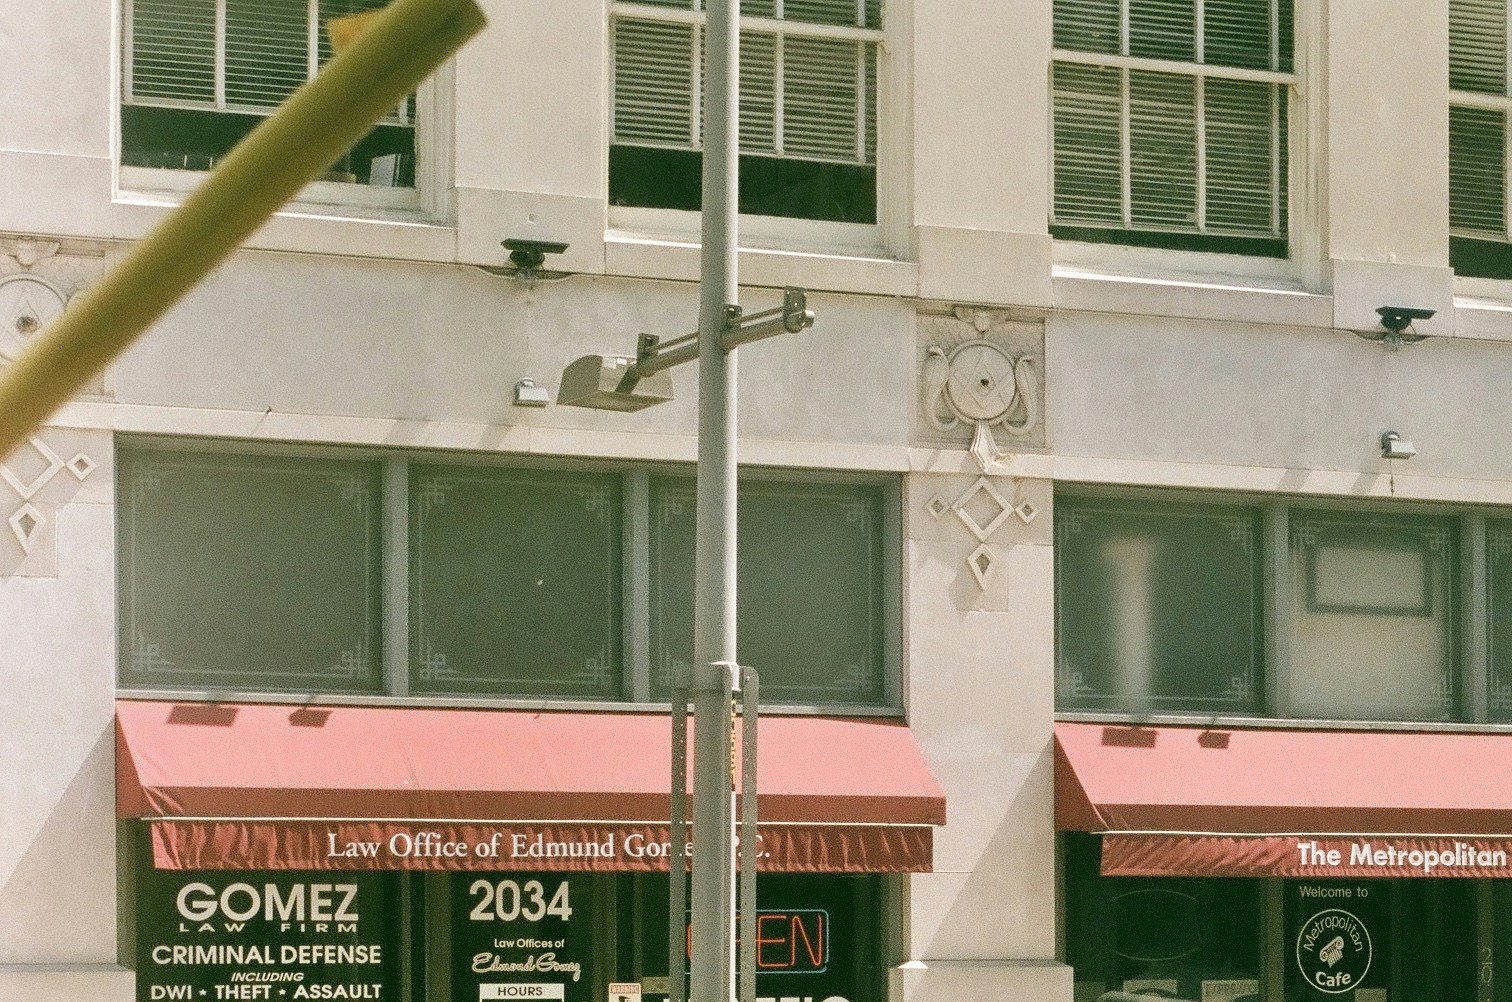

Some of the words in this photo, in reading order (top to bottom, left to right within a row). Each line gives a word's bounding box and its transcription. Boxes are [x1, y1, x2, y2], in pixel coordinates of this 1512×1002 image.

[327, 832, 381, 858] Law
[389, 832, 468, 858] Office
[475, 832, 503, 858] of
[511, 832, 616, 858] Edmund
[624, 833, 695, 858] Goe
[1297, 841, 1341, 866] The
[1349, 842, 1507, 873] Metropolitan
[1299, 886, 1352, 898] Welcome
[1357, 886, 1369, 898] to
[176, 882, 359, 922] GOMEZ
[469, 879, 573, 922] 2034
[179, 923, 246, 933] LAW
[280, 923, 358, 933] FIRM
[1303, 915, 1363, 952] Metropolitan
[494, 939, 515, 948] Law
[516, 938, 553, 948] Offices
[555, 938, 565, 948] of
[151, 945, 275, 965] CRIMINAL
[280, 945, 382, 964] DEFENSE
[230, 972, 305, 982] INCLUDING
[1315, 971, 1352, 987] Cafe
[150, 985, 192, 1000] DWI
[214, 984, 272, 1000] THEFT
[293, 984, 383, 999] ASSAULT
[498, 986, 543, 996] HOURS
